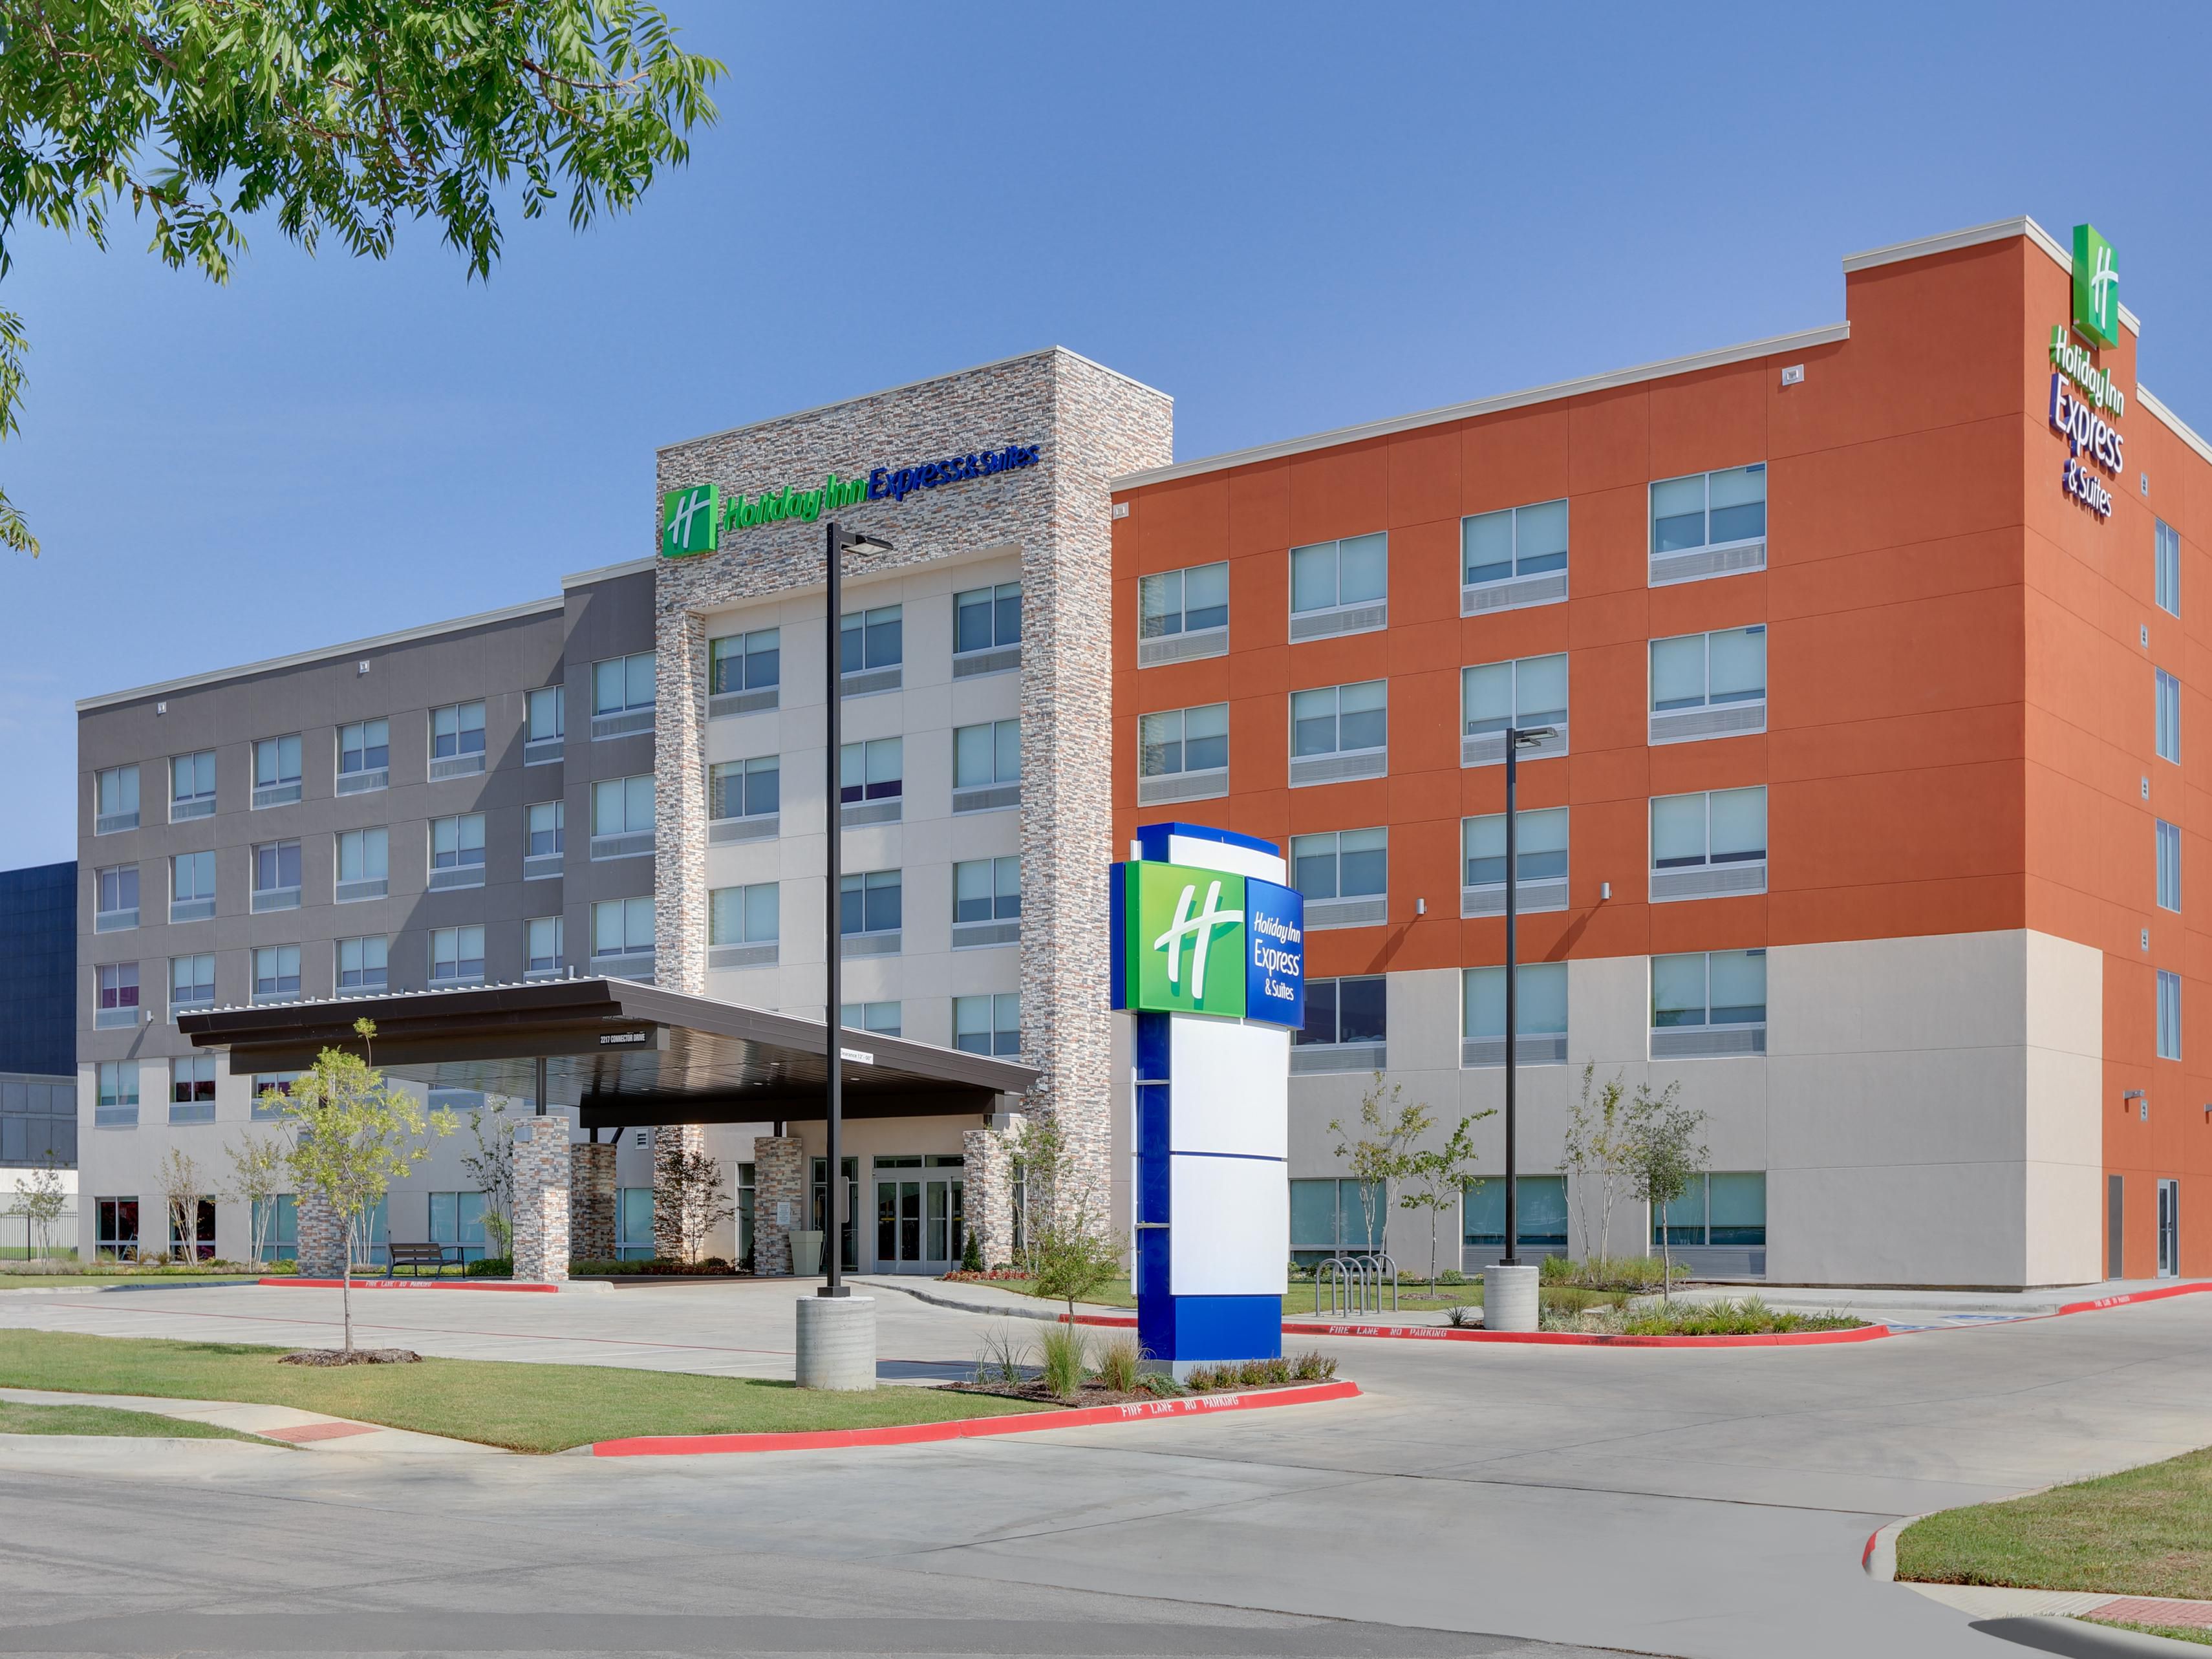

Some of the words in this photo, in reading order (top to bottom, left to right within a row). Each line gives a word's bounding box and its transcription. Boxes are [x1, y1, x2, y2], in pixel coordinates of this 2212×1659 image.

[2053, 325, 2105, 408] Holiday
[2105, 368, 2125, 418] Inn
[2052, 373, 2124, 474] Express
[724, 485, 824, 531] Holiday
[824, 473, 868, 509] Inn
[867, 456, 964, 502] Express
[979, 445, 1040, 476] Suites
[2065, 458, 2078, 493] &
[2079, 466, 2112, 517] Suites
[1254, 910, 1288, 944] Holiday
[1287, 921, 1301, 944] Inn
[1254, 938, 1300, 978] Express
[1265, 978, 1272, 996] &
[1272, 979, 1294, 1001] Suites
[610, 1034, 633, 1044] CONNECTOR
[633, 1033, 645, 1042] DRIVE
[1329, 1325, 1350, 1334] FIRE
[1357, 1326, 1380, 1336] LANE
[1390, 1327, 1402, 1336] NO
[1410, 1328, 1448, 1338] PARKING
[1148, 1401, 1174, 1415] LANE
[1183, 1399, 1197, 1411] NO
[1202, 1395, 1239, 1408] PARKING
